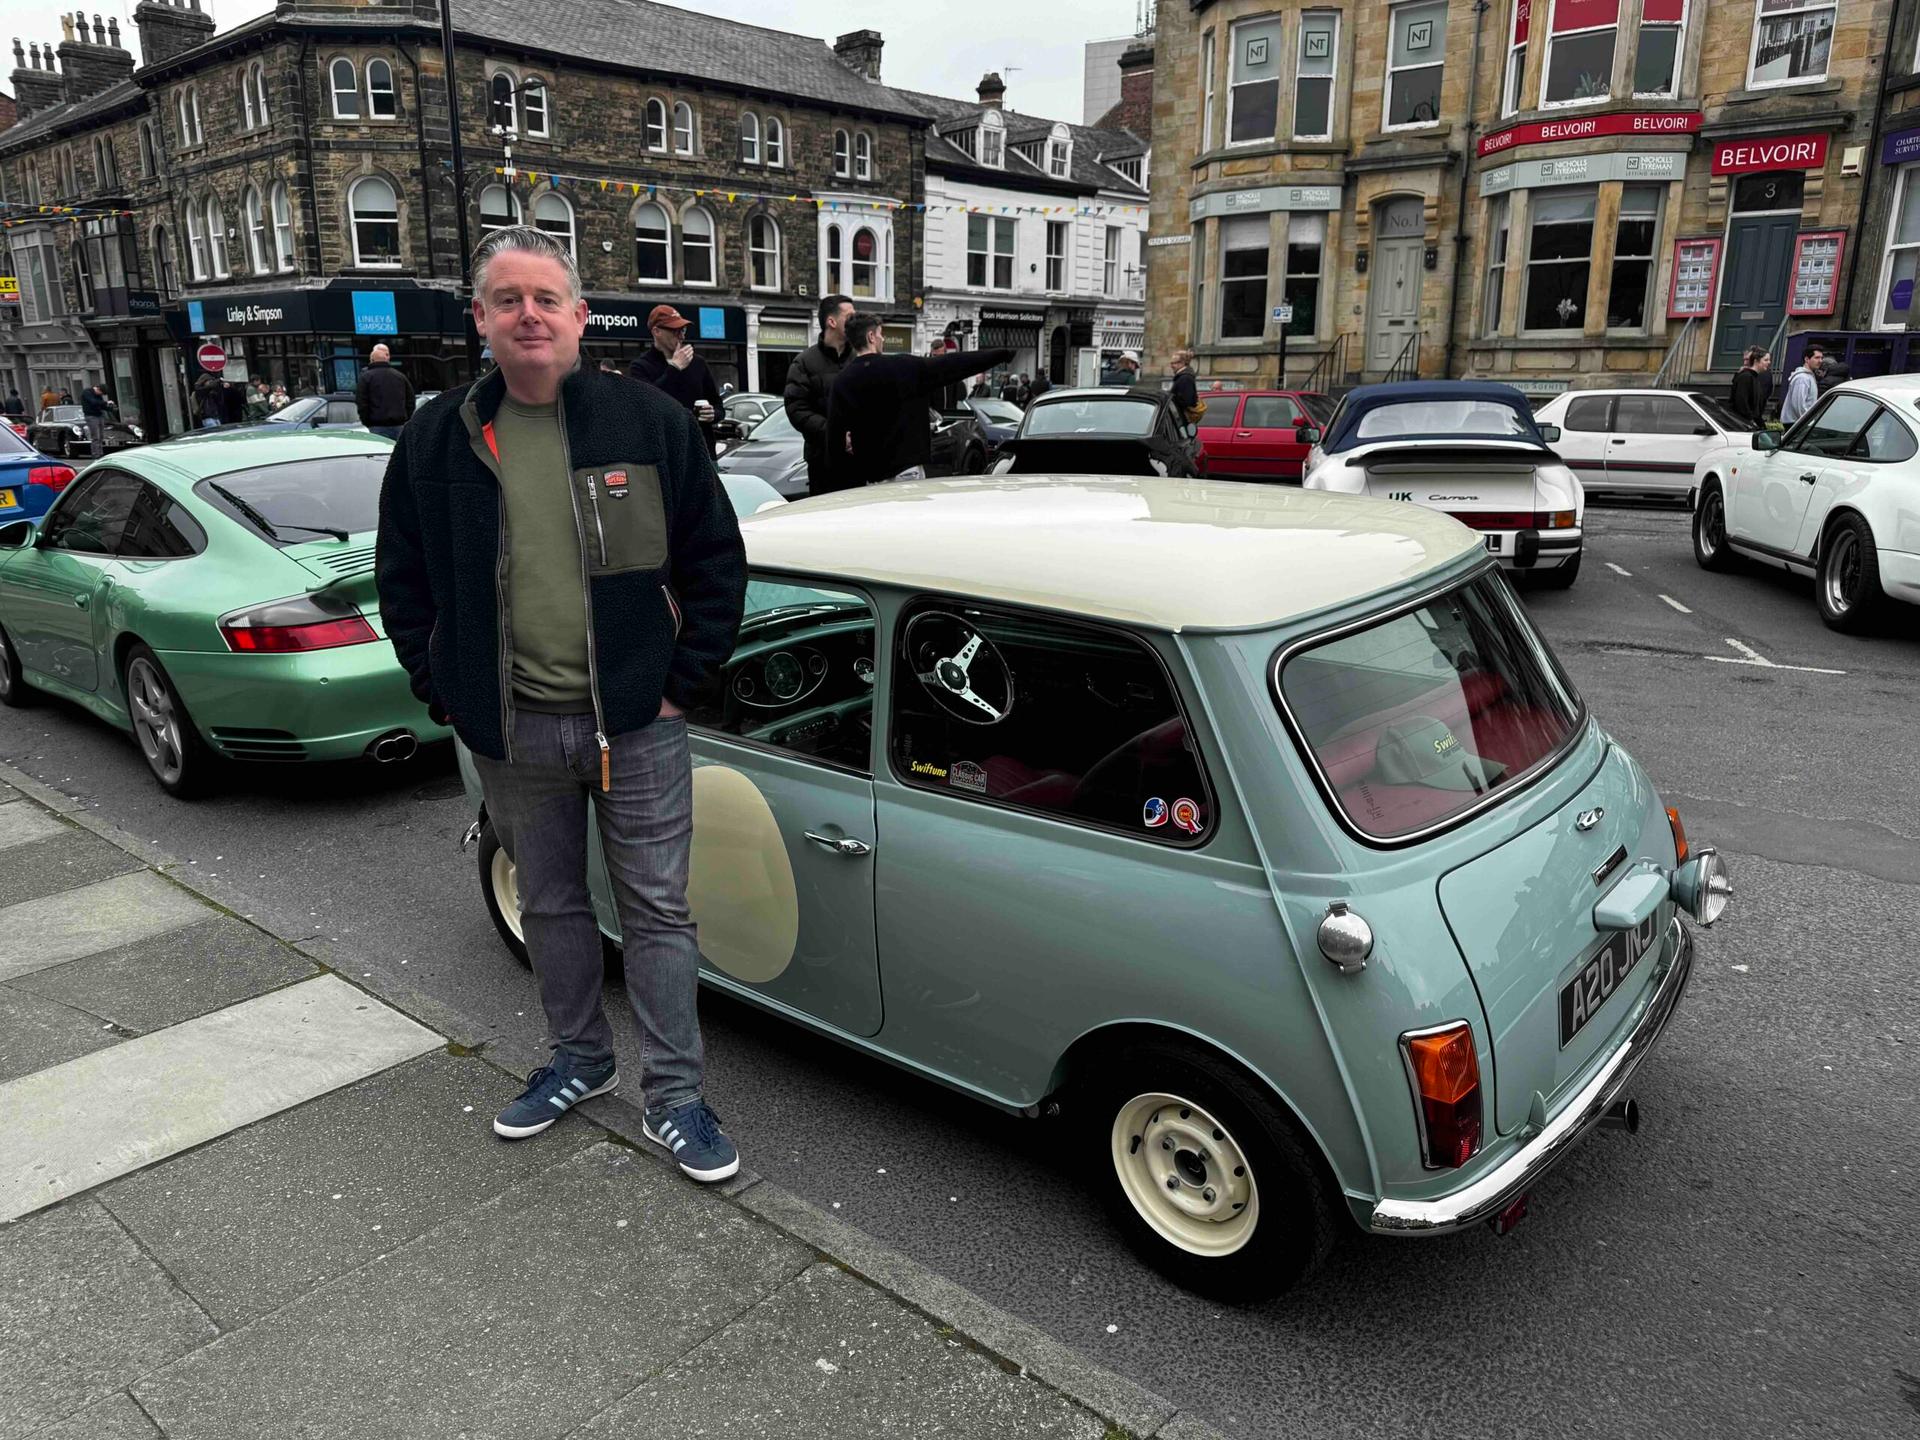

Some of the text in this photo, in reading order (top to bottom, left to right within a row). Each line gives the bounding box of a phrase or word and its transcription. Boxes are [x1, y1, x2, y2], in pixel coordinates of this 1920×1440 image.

[1412, 29, 1427, 42] NT
[1310, 39, 1325, 50] NT
[1250, 45, 1264, 58] NT
[1541, 121, 1595, 138] BELVOIR!
[1633, 117, 1688, 130] BELVOIR!
[1484, 133, 1512, 151] BELVOIR!
[1640, 156, 1673, 164] NICHOLLS
[1720, 142, 1817, 167] BELVOIR!
[1555, 160, 1588, 168] NICHOLLS
[1555, 166, 1587, 174] TYREMAN
[1640, 162, 1673, 170] TYREMAN
[1764, 183, 1776, 199] 3
[226, 307, 246, 326] Linley
[247, 307, 253, 321] &
[253, 305, 283, 325] Simpson
[357, 315, 384, 324] LINLEY
[358, 322, 394, 332] SIMPSON
[1389, 492, 1413, 501] UK
[911, 761, 947, 777] Swiftune
[1572, 947, 1614, 1032] A20
